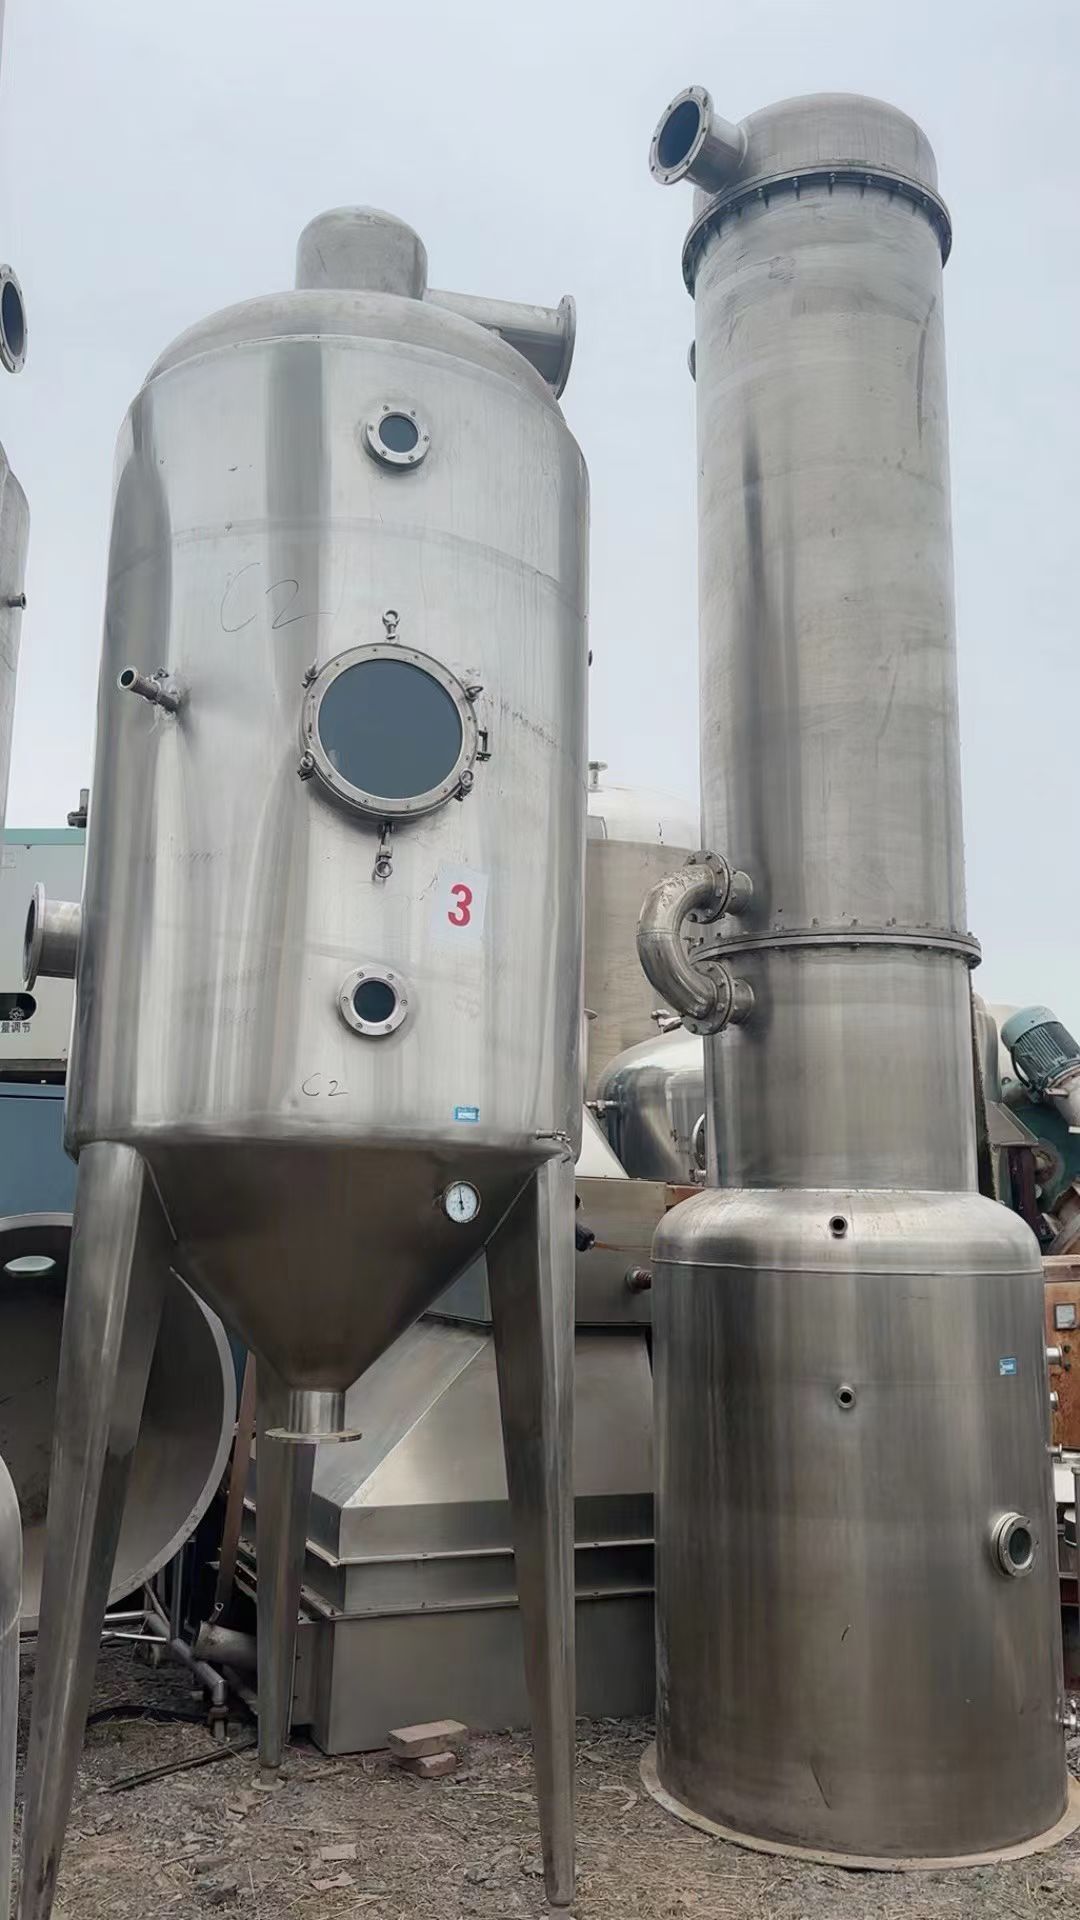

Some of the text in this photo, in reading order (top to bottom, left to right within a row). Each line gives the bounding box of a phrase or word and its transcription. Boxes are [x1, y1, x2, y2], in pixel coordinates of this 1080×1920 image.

[220, 562, 335, 632] C2
[447, 883, 473, 927] 3
[301, 1072, 349, 1097] C2
